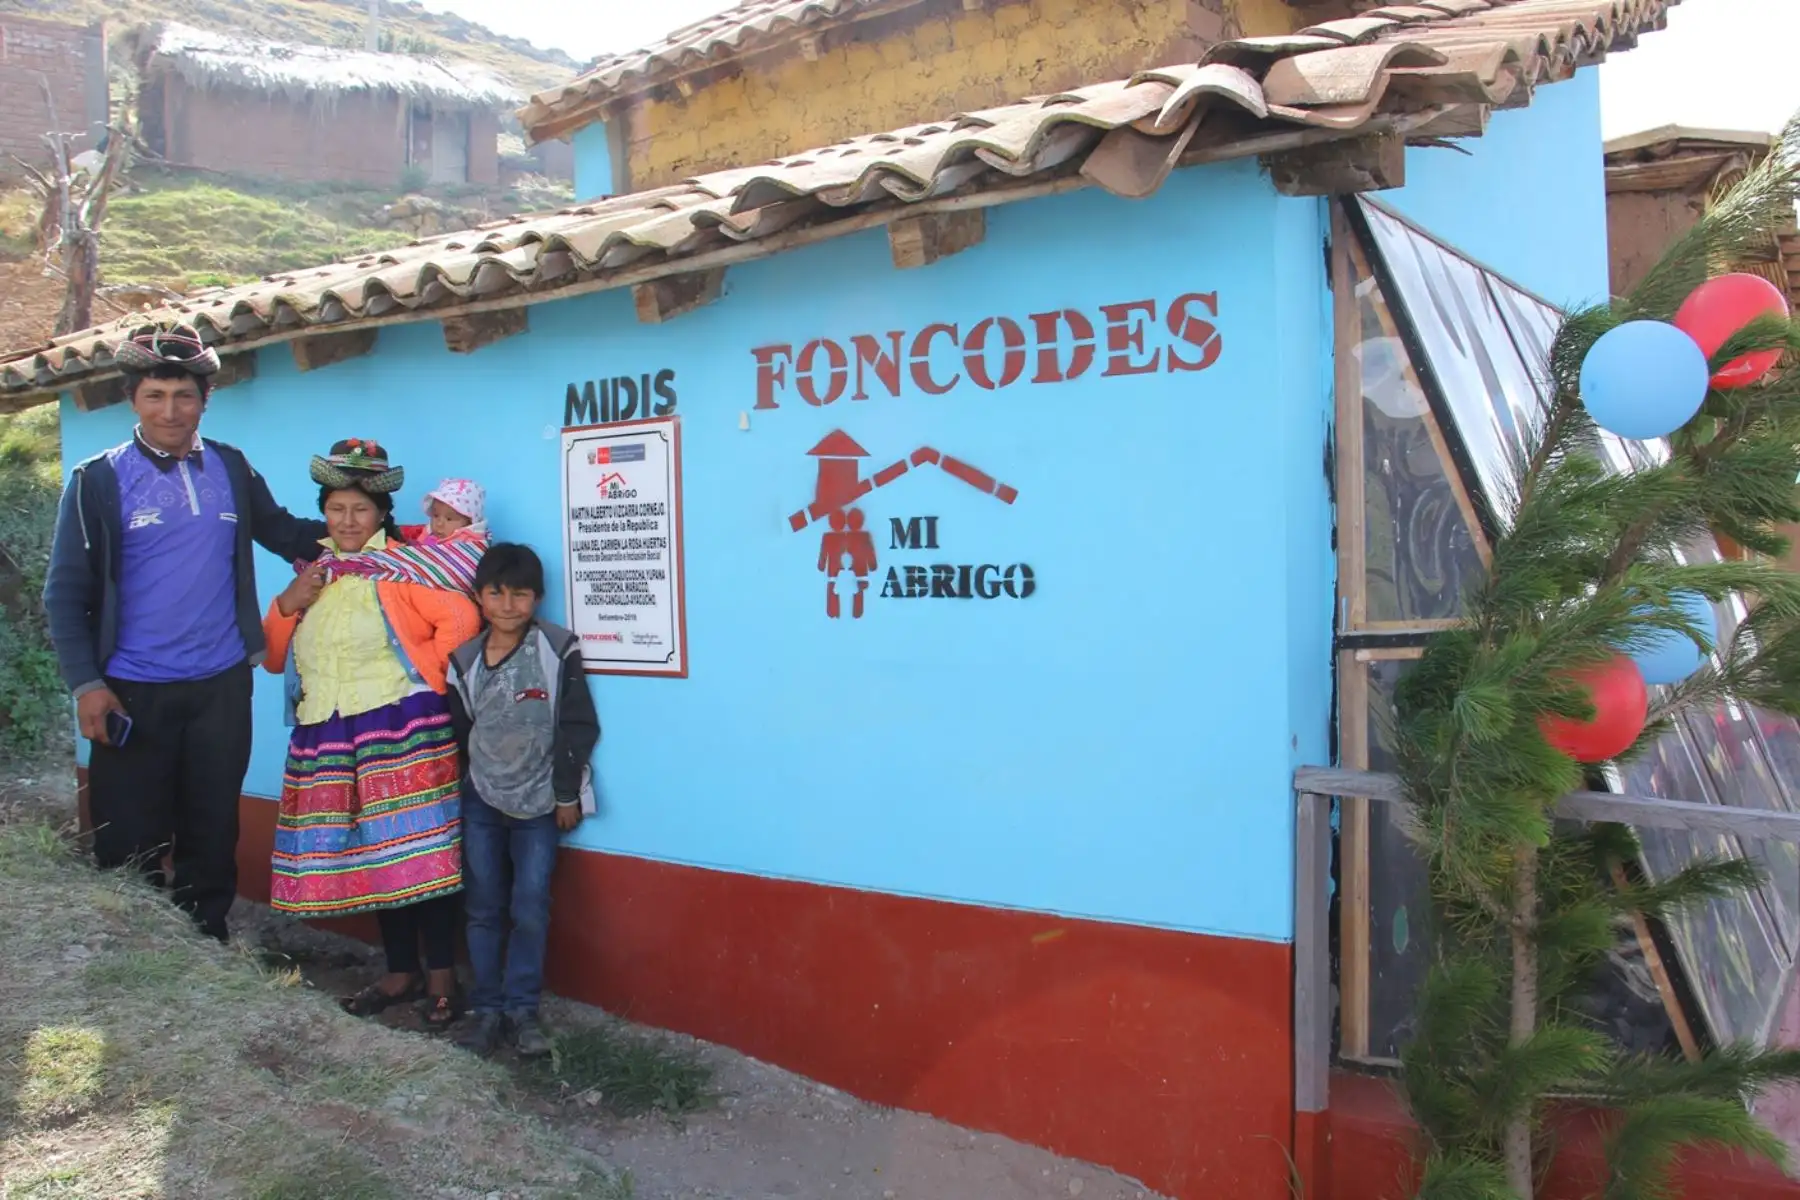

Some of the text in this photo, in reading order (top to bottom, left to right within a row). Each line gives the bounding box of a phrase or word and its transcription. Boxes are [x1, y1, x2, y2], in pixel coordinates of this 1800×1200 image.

[750, 290, 1223, 410] FONCODES
[563, 368, 678, 426] MIDIS
[578, 521, 611, 533] Presidente
[611, 520, 619, 532] de
[619, 520, 626, 531] la
[591, 539, 601, 551] DEL
[600, 538, 621, 551] CARMEN
[621, 538, 628, 550] LA
[628, 537, 642, 550] ROSA
[888, 515, 940, 549] MI
[880, 563, 1036, 599] ABRIGO
